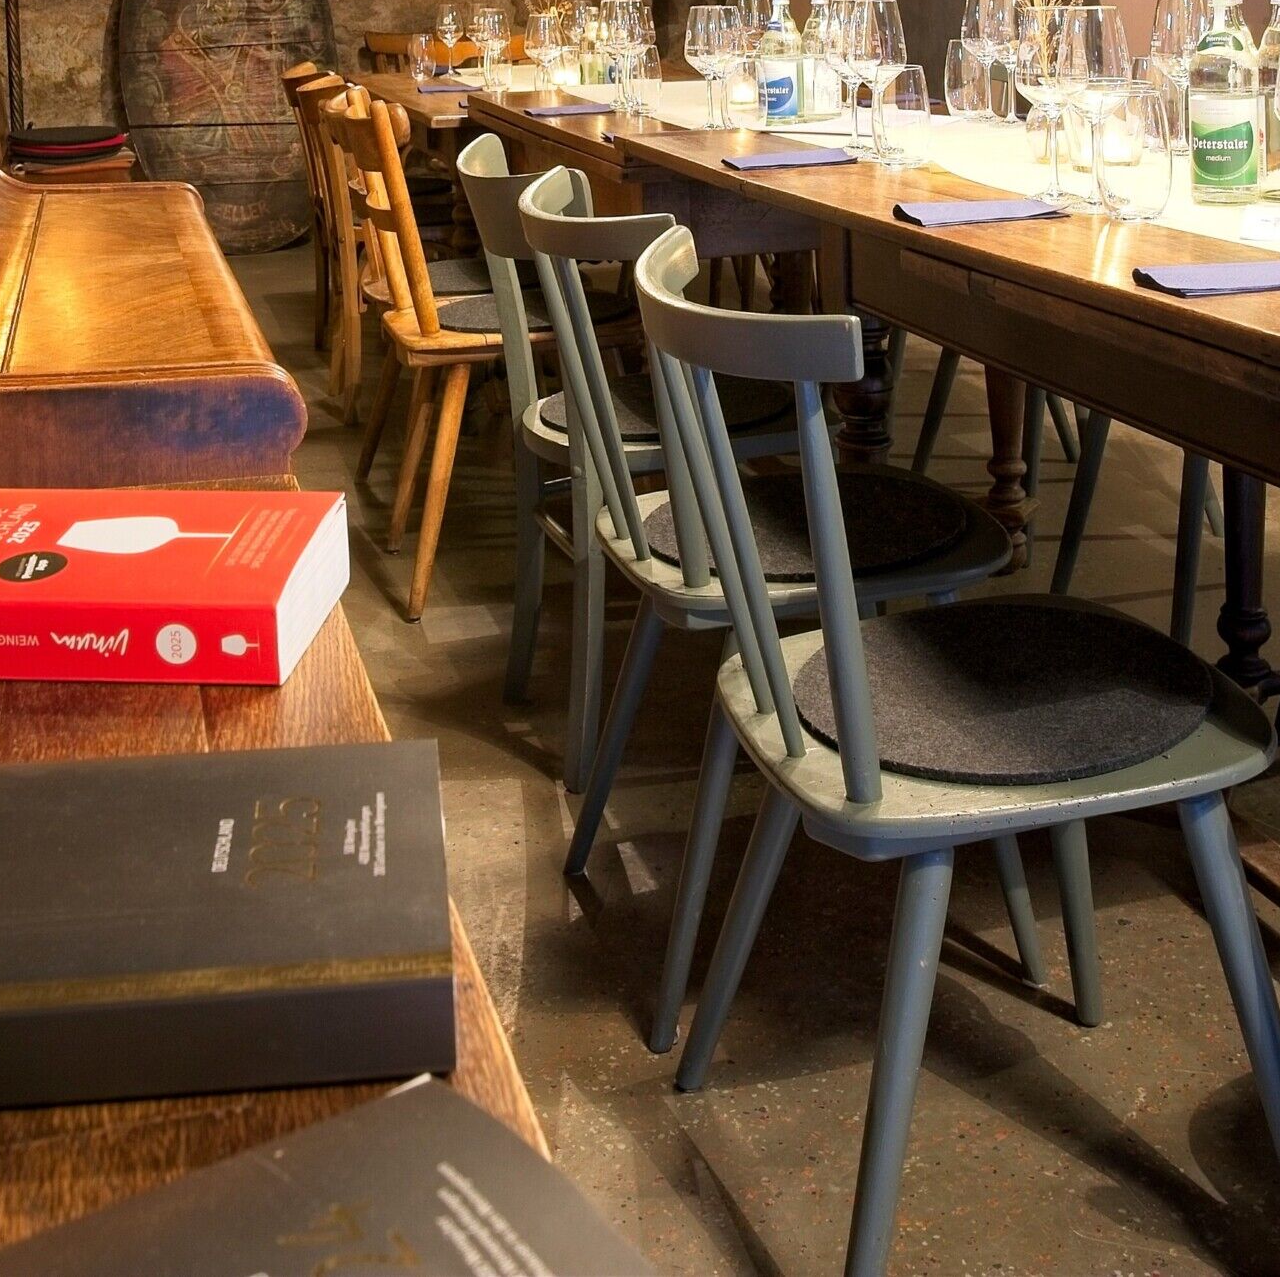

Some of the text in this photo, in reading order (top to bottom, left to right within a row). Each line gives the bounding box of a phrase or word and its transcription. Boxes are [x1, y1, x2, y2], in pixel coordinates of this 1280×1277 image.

[1193, 138, 1249, 151] Peterstaler
[1205, 154, 1232, 162] medium
[6, 521, 41, 544] 2025
[170, 629, 184, 660] 2025
